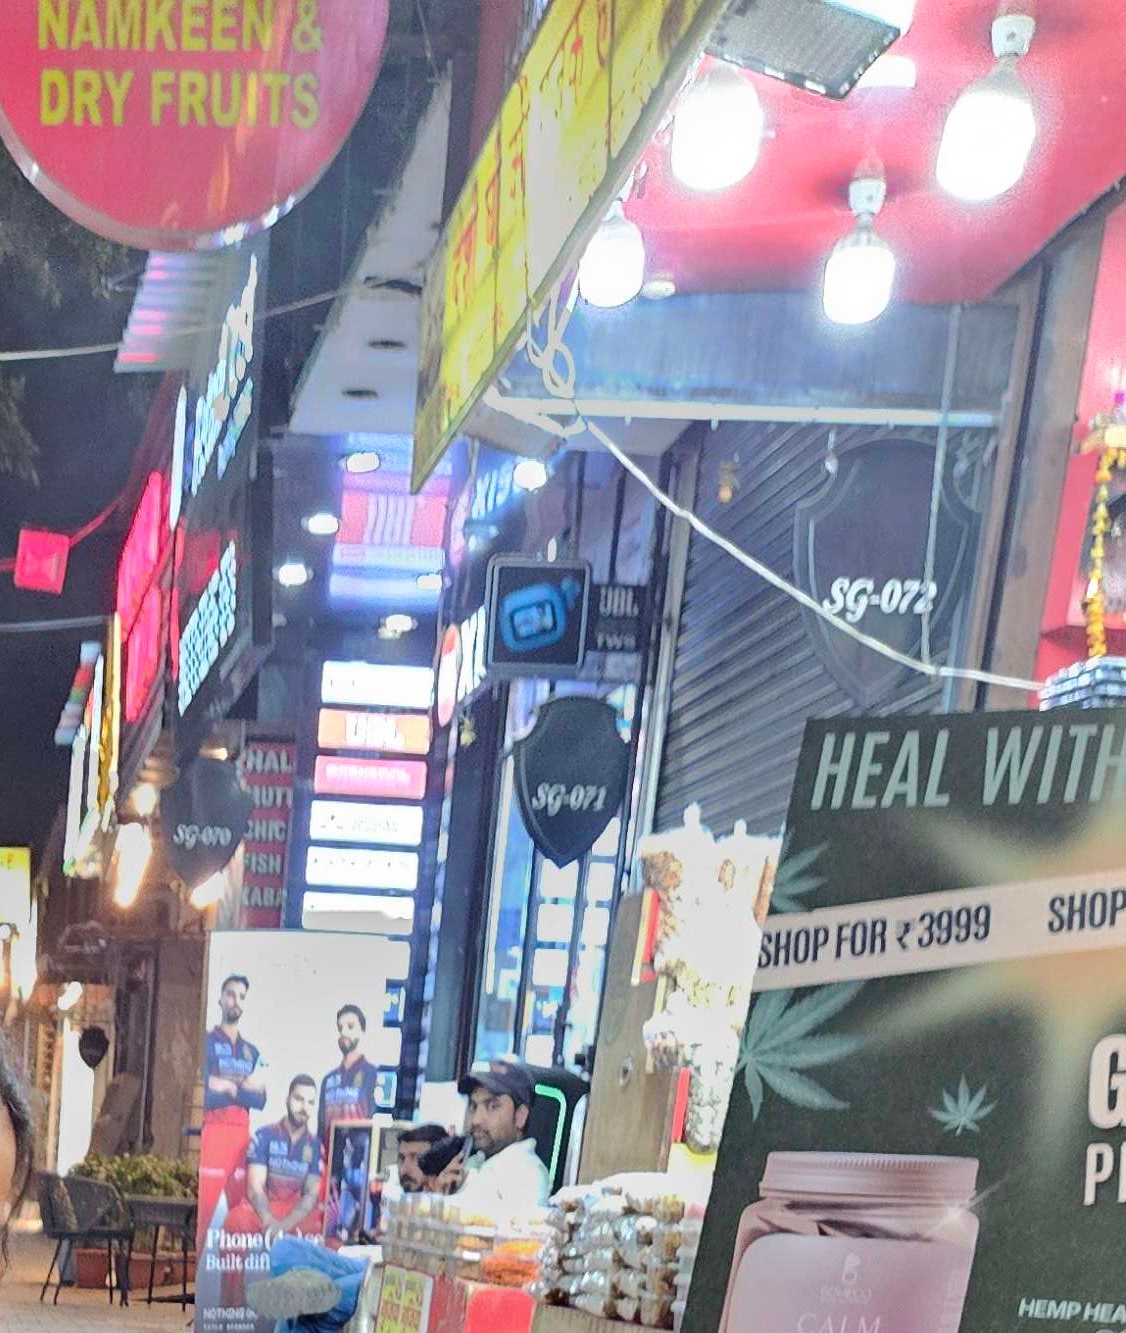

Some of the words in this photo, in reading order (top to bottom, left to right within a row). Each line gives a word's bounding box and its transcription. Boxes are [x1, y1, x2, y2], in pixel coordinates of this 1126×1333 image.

[36, 0, 275, 52] NAMKEEN
[292, 0, 324, 52] &
[39, 69, 134, 127] DRY
[150, 69, 320, 129] FRUITS
[822, 577, 937, 623] SG-072
[810, 727, 951, 811] HEAL
[982, 723, 1126, 806] WITH
[531, 782, 608, 817] SG-071
[173, 823, 233, 850] SG-070
[758, 926, 830, 969] SHOP
[834, 917, 888, 960] FOR
[1047, 888, 1126, 934] SHOP
[207, 1228, 263, 1250] Phone
[206, 1253, 243, 1272] Built
[1017, 1297, 1082, 1320] HEMP
